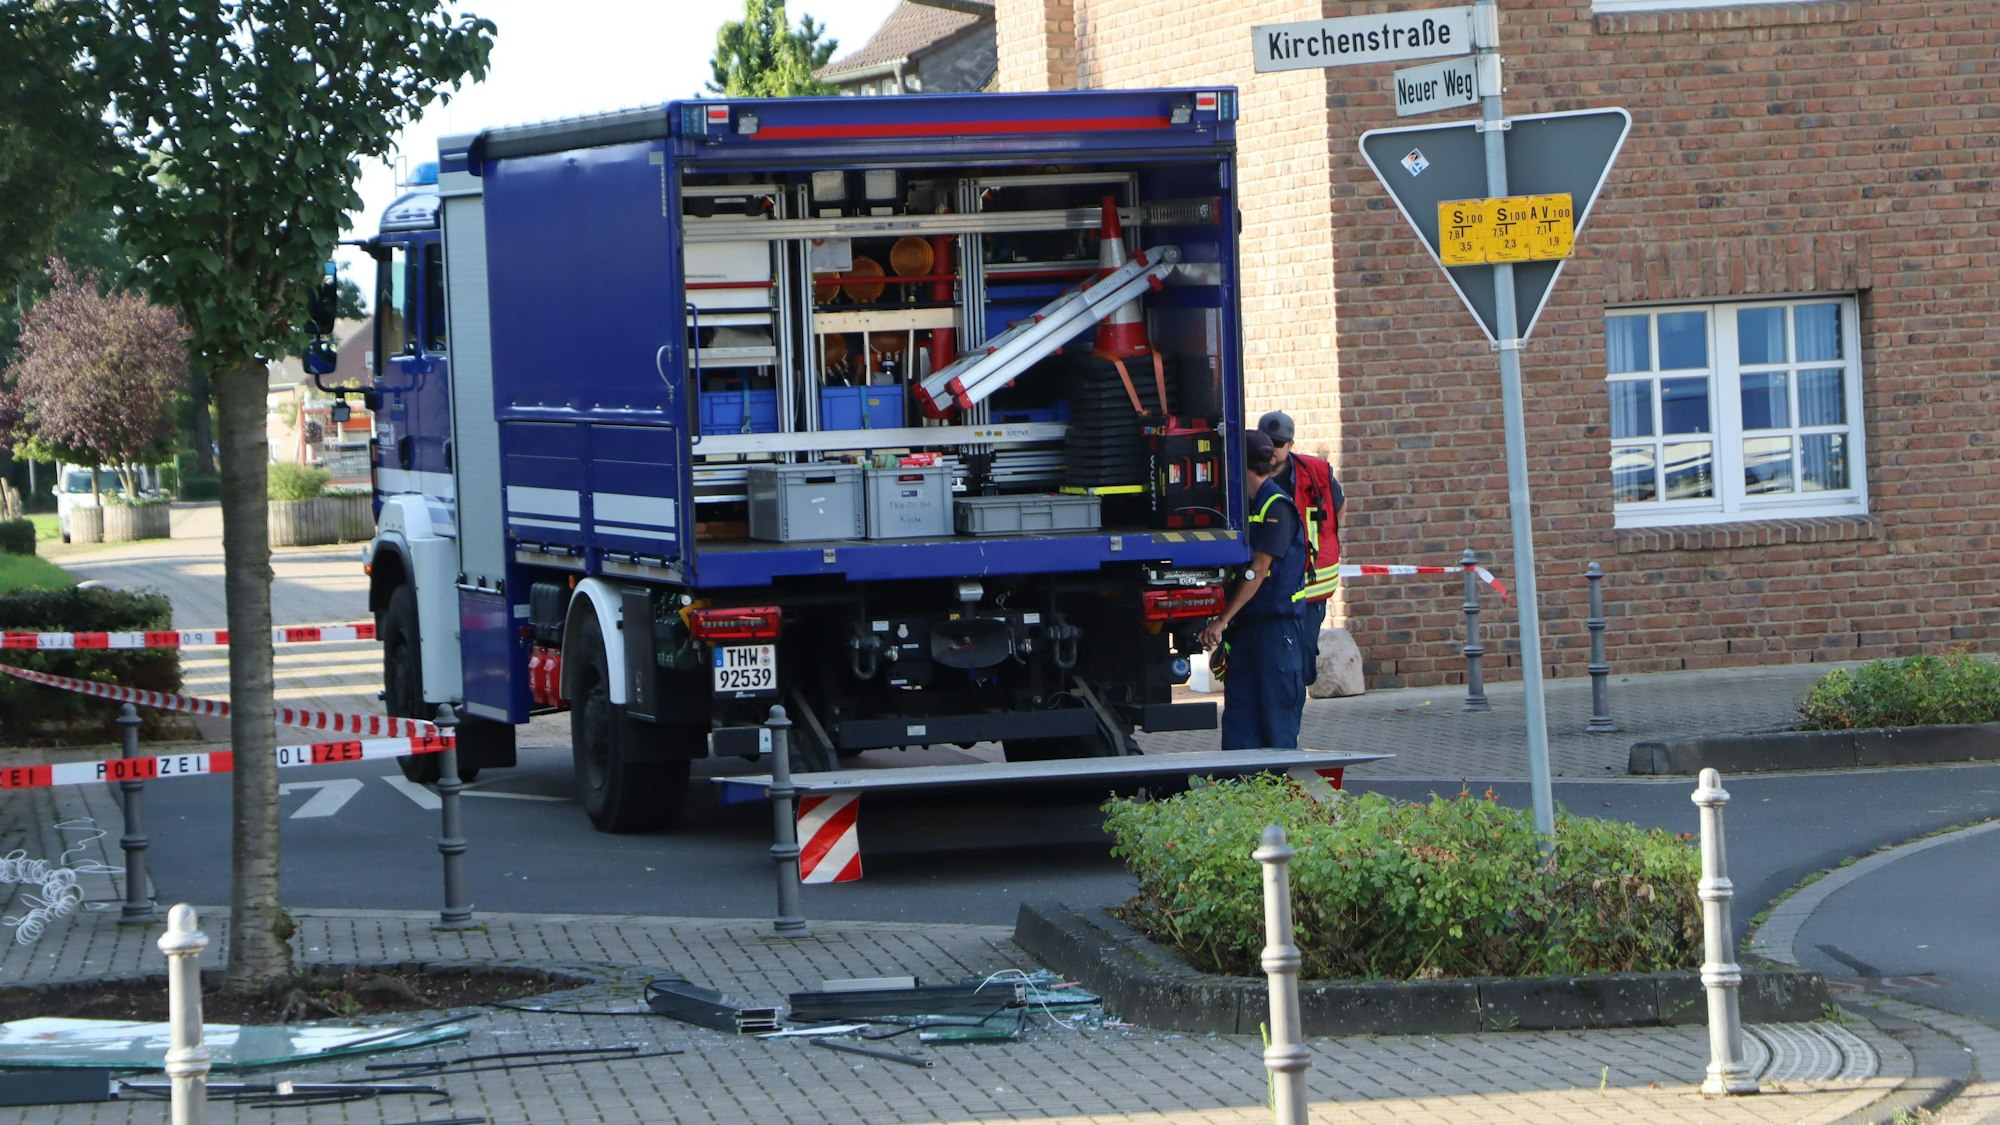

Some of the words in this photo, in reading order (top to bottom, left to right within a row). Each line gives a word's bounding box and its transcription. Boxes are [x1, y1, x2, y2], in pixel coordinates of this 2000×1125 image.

[1268, 18, 1451, 60] Kirchenstraße
[1397, 78, 1438, 106] Neuer
[1443, 68, 1473, 101] Weg
[726, 647, 758, 667] THW
[720, 668, 771, 689] 92539
[96, 756, 201, 780] POLIZEI
[279, 741, 363, 765] OLIZEI
